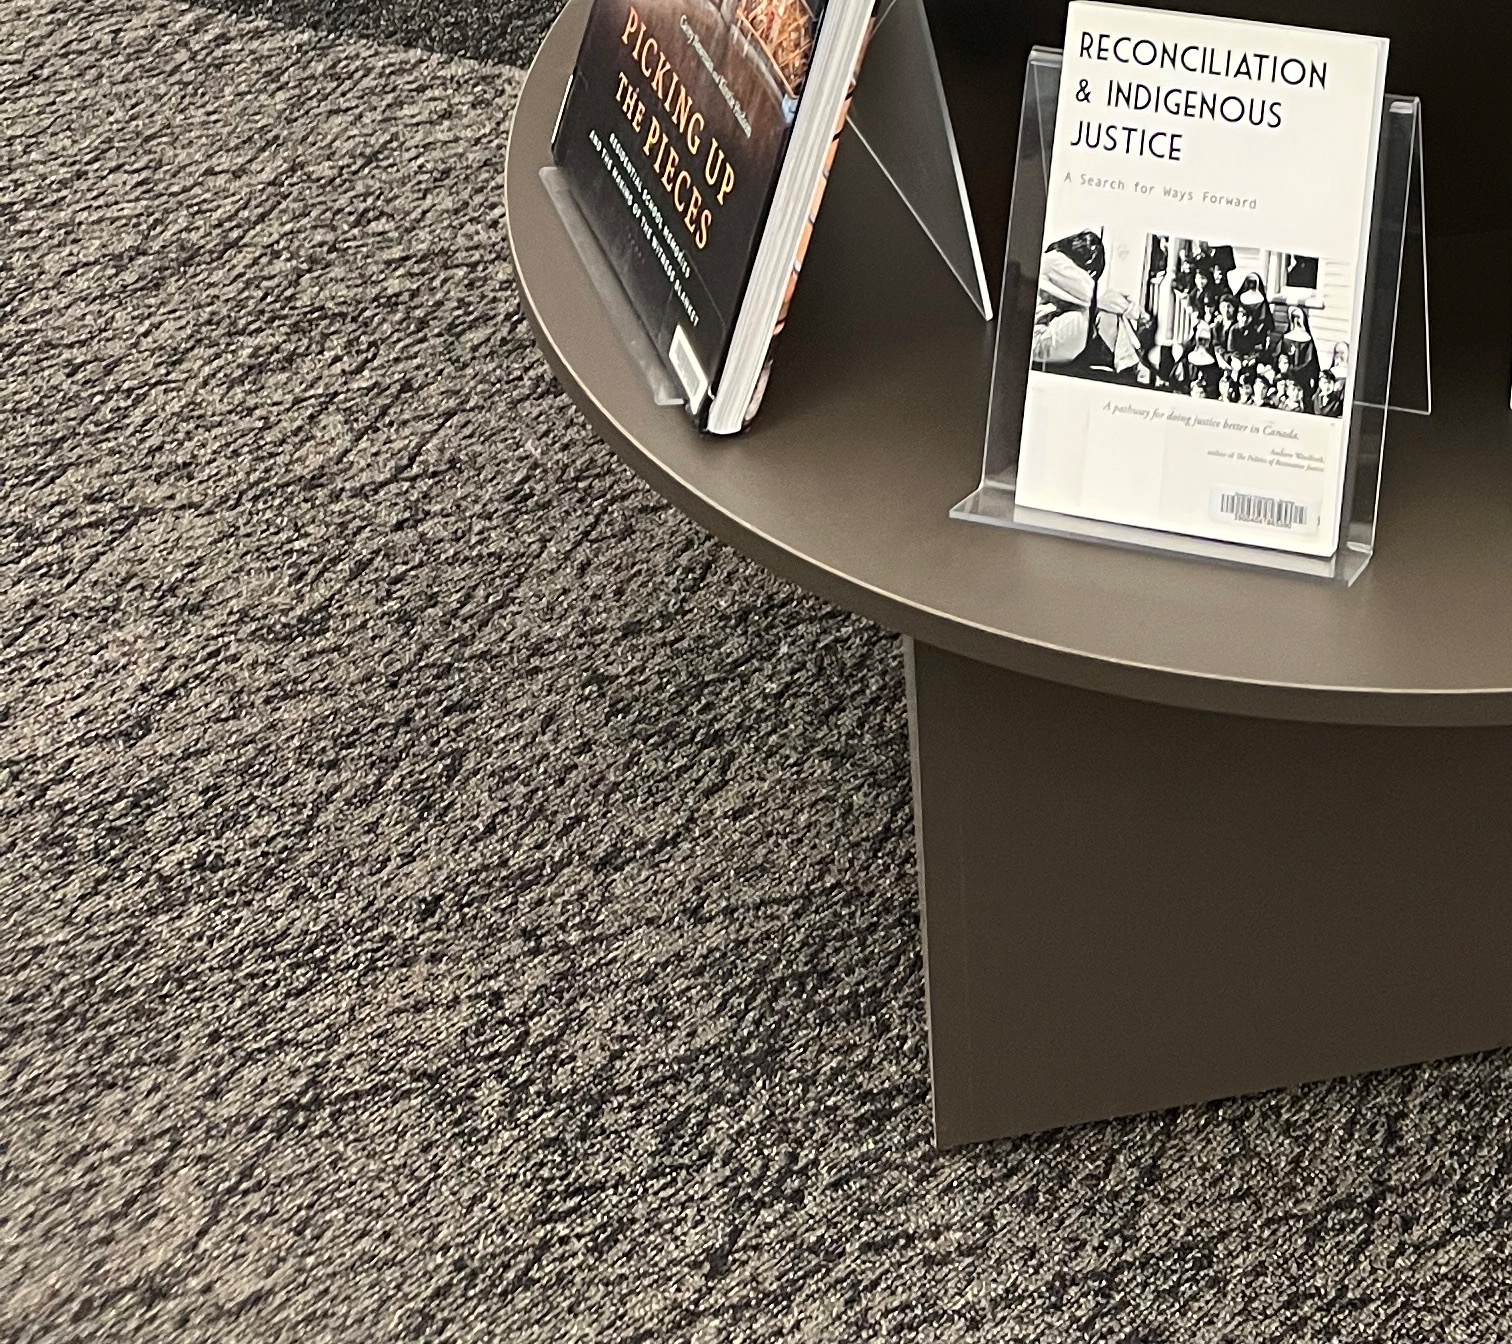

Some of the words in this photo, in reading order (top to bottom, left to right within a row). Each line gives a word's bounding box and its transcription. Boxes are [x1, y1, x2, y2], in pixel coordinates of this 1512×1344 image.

[1079, 31, 1328, 91] RECONCILIATION
[621, 5, 705, 155] PICKING
[704, 137, 736, 206] UP
[1075, 78, 1091, 103] &
[1106, 80, 1283, 129] INDIGENOUS
[615, 71, 647, 134] THE
[642, 115, 713, 250] PIECES
[1070, 120, 1184, 161] JUSTICE
[609, 132, 643, 193] RESIDENTIAL
[642, 188, 664, 231] SCHOOL
[663, 224, 690, 279] MEMORIES
[1063, 171, 1073, 184] A
[1080, 173, 1125, 191] Search
[1134, 181, 1155, 195] for
[1163, 186, 1194, 202] Ways
[1202, 191, 1258, 210] Forward
[588, 129, 603, 153] AND
[601, 147, 613, 172] THE
[612, 166, 634, 207] MAKING
[632, 202, 642, 219] OF
[640, 215, 653, 241] THE
[651, 234, 676, 283] WITNESS
[674, 278, 699, 328] BLANKET
[1103, 400, 1111, 411] A
[1112, 403, 1150, 419] pathway
[1149, 407, 1165, 421] for
[1166, 410, 1192, 427] doing
[1191, 415, 1221, 428] justice
[1223, 417, 1249, 432] better
[1250, 423, 1260, 434] in
